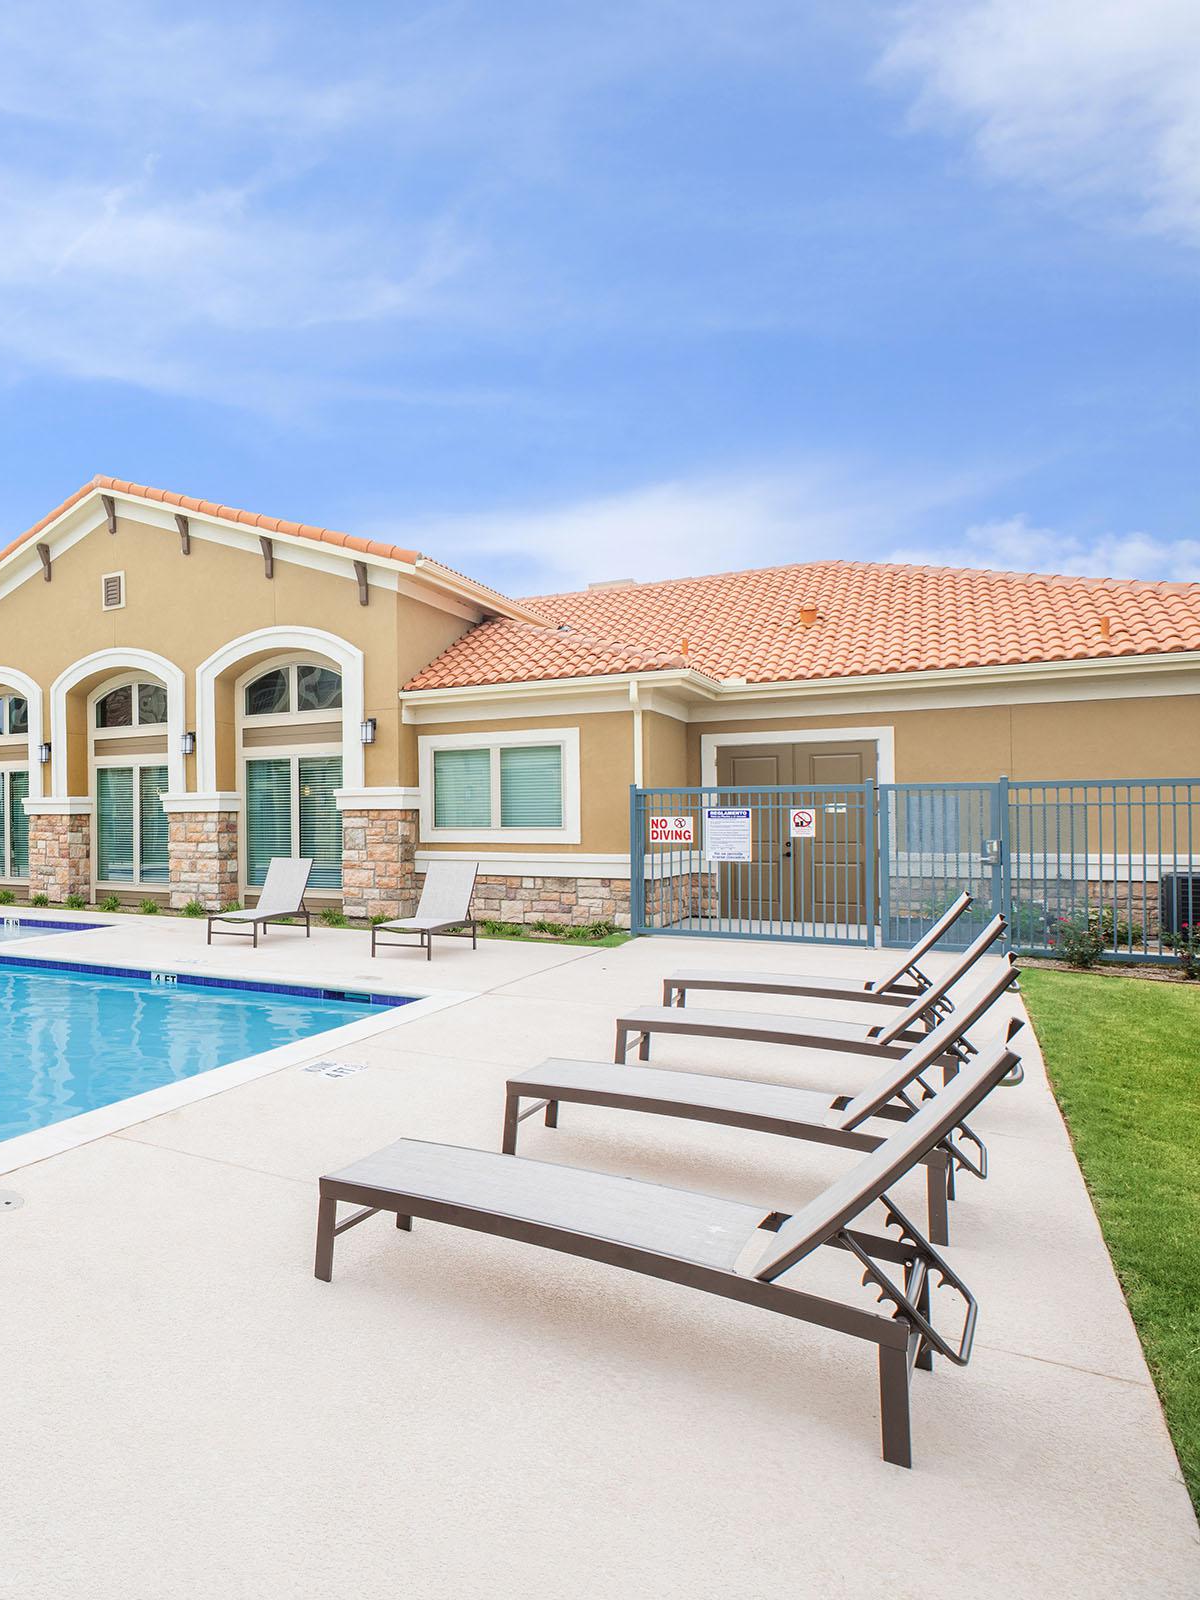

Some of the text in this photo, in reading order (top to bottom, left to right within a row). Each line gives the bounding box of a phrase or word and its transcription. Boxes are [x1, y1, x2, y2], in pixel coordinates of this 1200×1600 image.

[651, 819, 668, 829] NO
[651, 830, 691, 840] DIVING
[164, 975, 176, 983] FT
